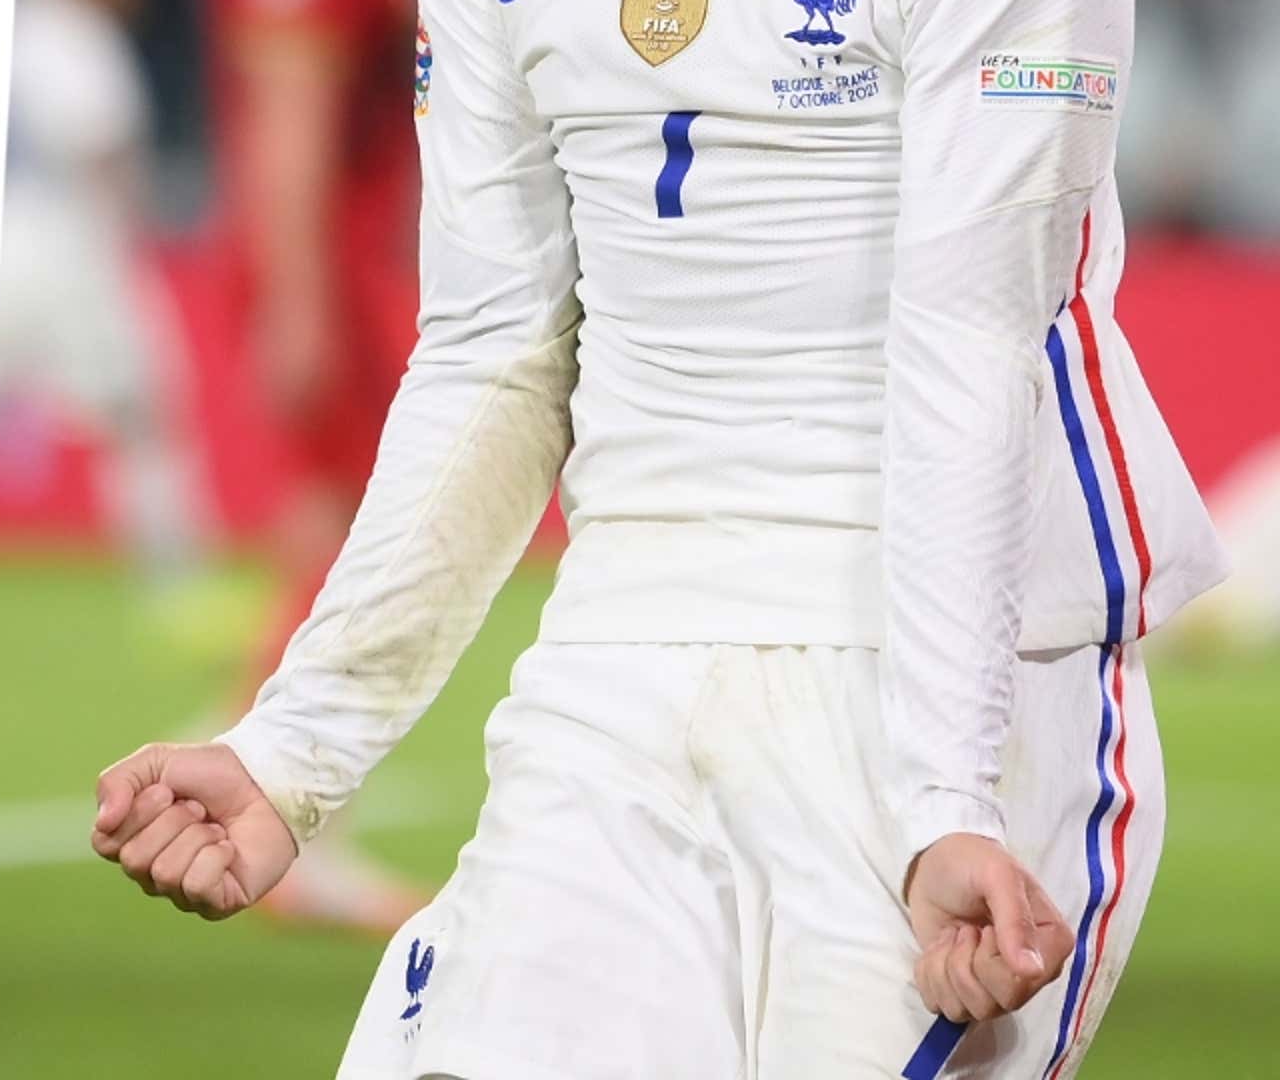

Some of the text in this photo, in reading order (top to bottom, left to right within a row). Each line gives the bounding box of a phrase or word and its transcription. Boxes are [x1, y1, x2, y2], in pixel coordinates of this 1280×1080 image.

[643, 18, 679, 34] FIFA
[981, 55, 1020, 67] UEFA
[835, 64, 880, 89] FRANCE
[981, 70, 1117, 96] FOUNDATION
[777, 81, 880, 110] 7 OCTOBRE 2021
